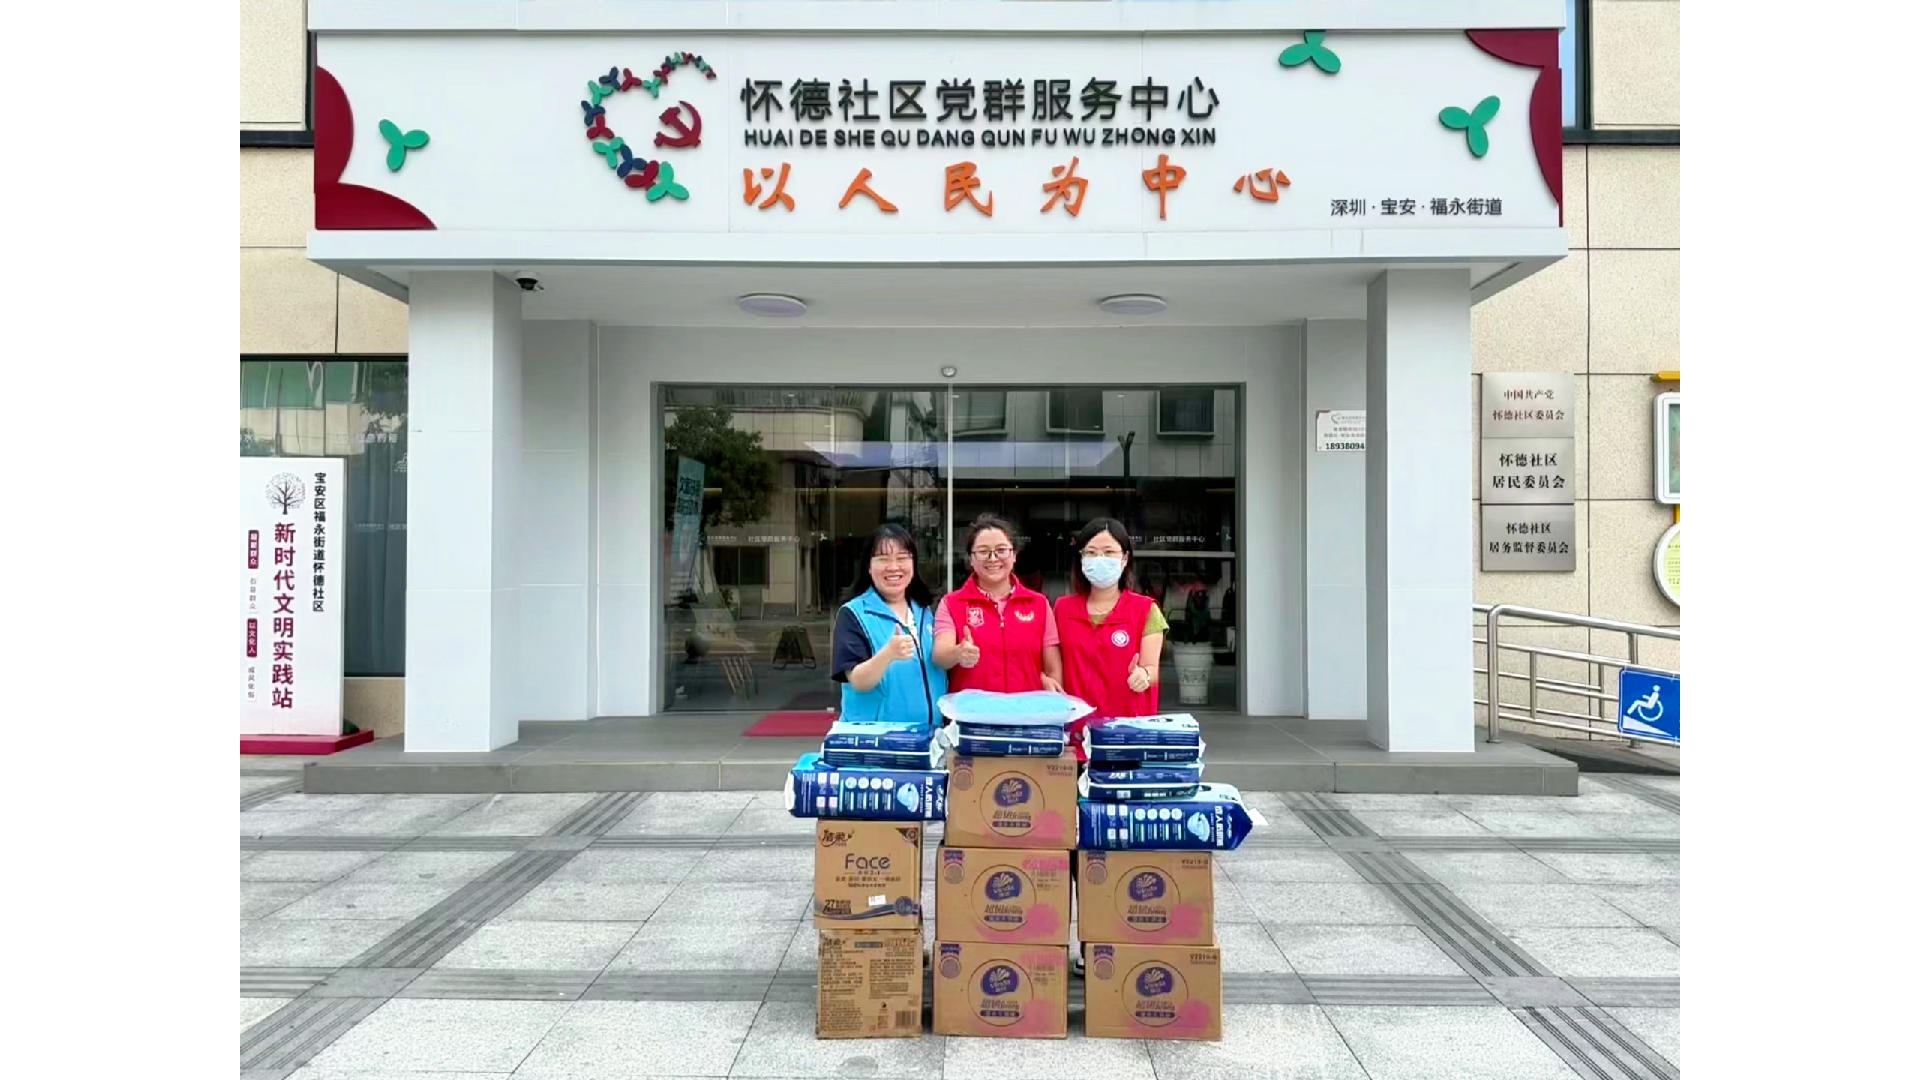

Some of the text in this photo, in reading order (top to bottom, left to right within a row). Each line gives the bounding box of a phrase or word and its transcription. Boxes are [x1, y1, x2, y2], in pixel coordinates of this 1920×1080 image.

[739, 76, 1220, 123] 怀德社区党群服务中心
[745, 128, 1216, 149] HUAI DE SHE QU DANG QUN FU WU ZHONG XIN
[743, 155, 1290, 219] 以人民为中心
[1503, 389, 1554, 401] 中国共产党
[1492, 409, 1565, 422] 怀德社区委员会
[1499, 453, 1558, 468] 怀德社区
[1492, 475, 1566, 489] 居民委员会
[1506, 522, 1552, 535] 怀德社区
[312, 472, 327, 612] 宝安区福永街道怀德社区
[1489, 541, 1569, 555] 居务监督委员会
[271, 522, 297, 709] 新时代文明实践站
[845, 852, 891, 871] Face
